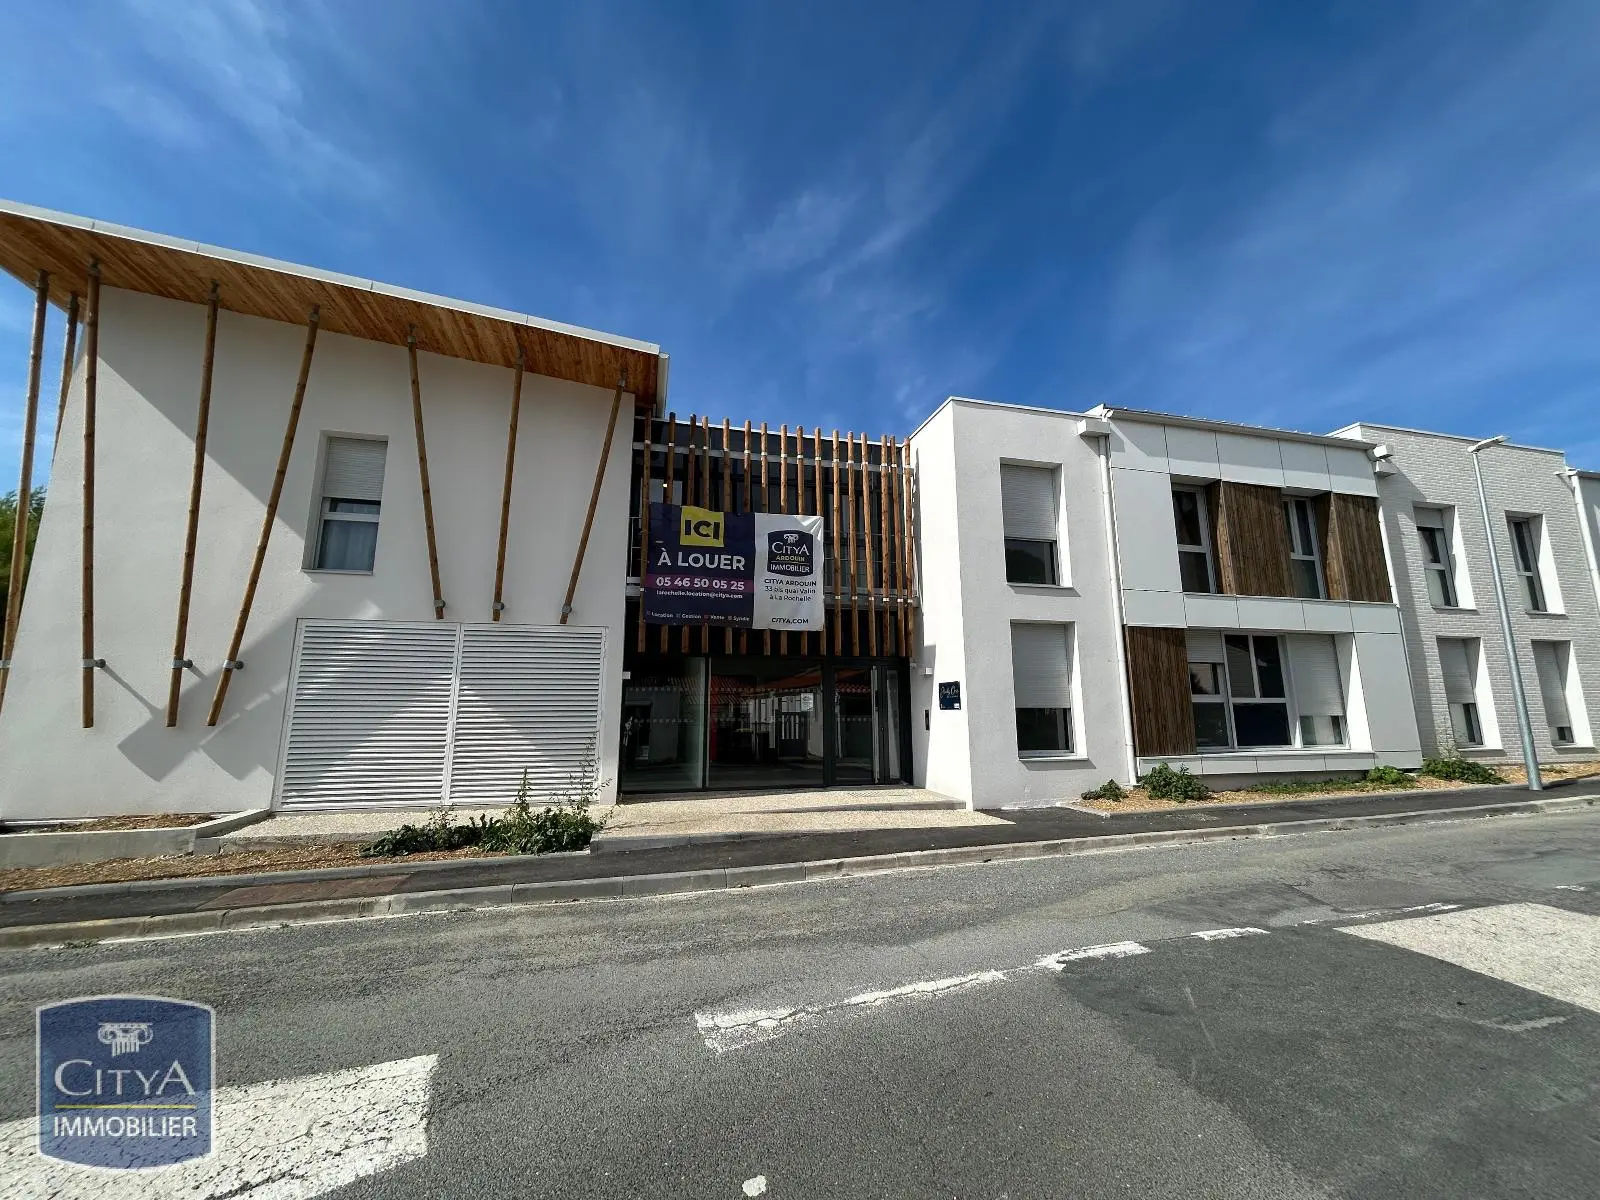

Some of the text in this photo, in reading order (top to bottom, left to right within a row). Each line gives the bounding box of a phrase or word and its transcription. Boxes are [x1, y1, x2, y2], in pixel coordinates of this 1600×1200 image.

[685, 519, 720, 540] ICI
[772, 542, 810, 556] CITYA
[658, 548, 745, 571] À LOUER
[770, 564, 810, 572] IMMOBILIER
[656, 576, 745, 590] 05 46 50 05 25
